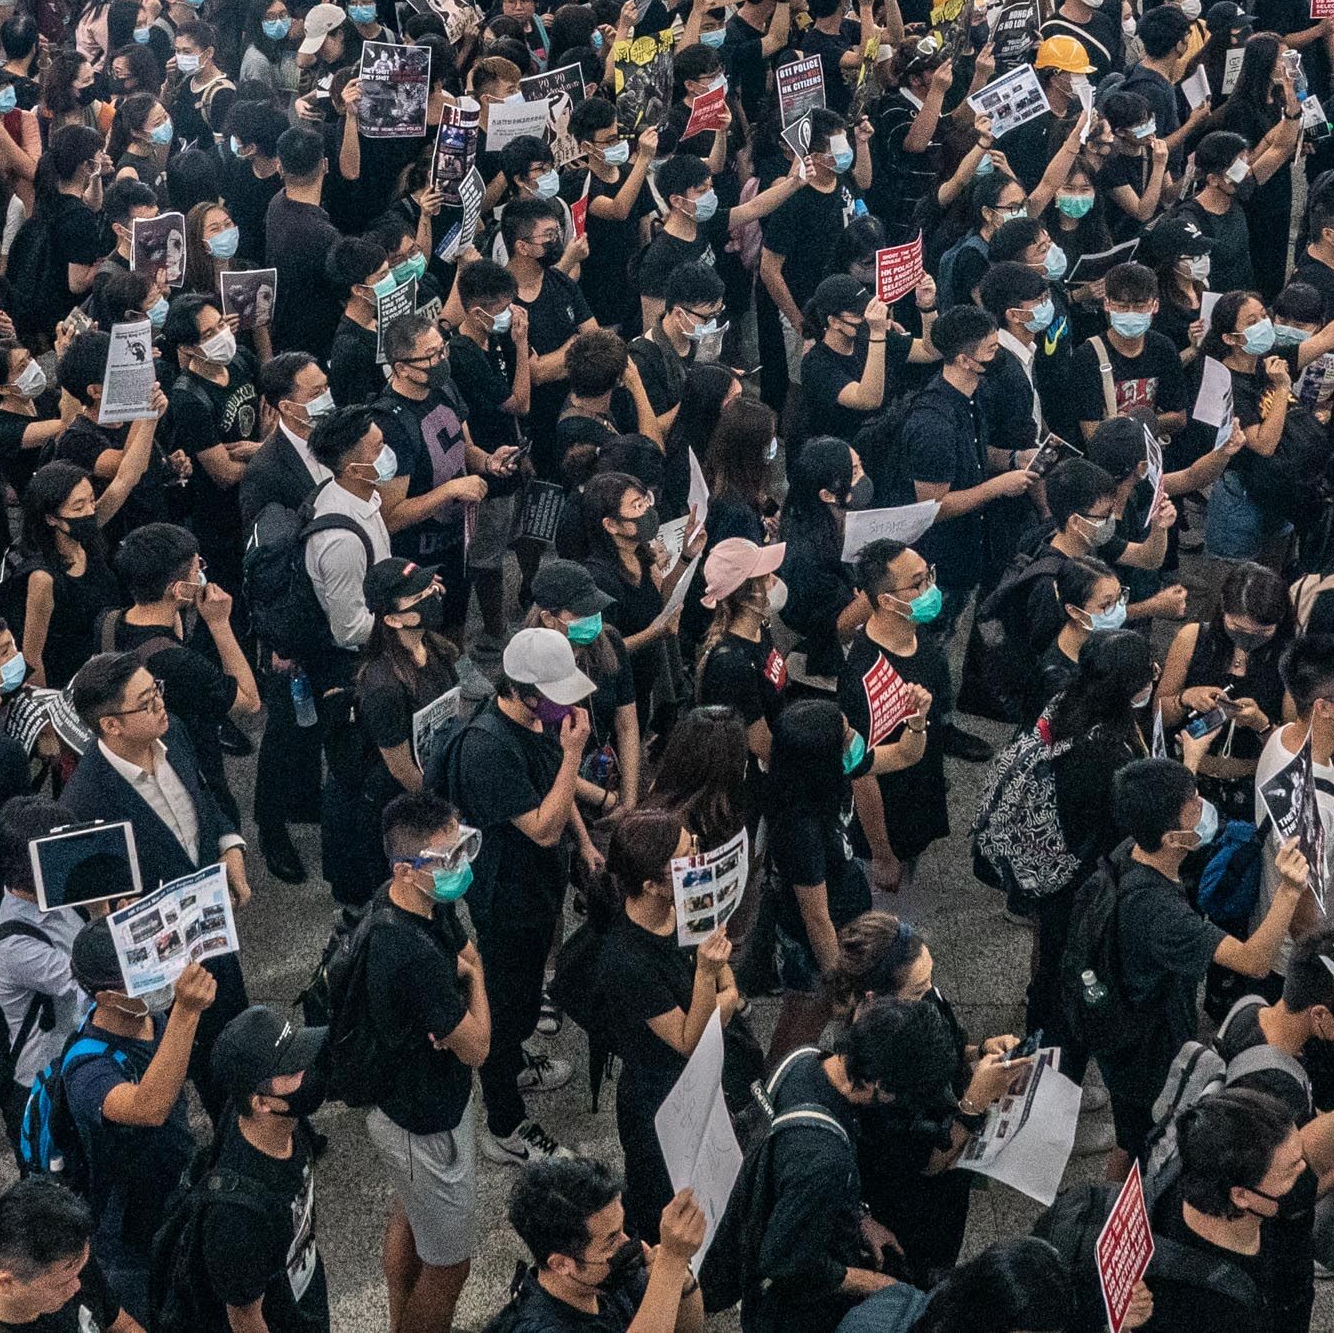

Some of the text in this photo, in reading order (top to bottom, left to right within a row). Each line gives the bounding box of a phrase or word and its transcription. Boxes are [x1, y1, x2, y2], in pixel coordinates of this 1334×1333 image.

[779, 58, 819, 79] 811 POLICE
[782, 74, 821, 94] HK CITIZENS
[882, 252, 898, 260] SHOOT
[881, 261, 913, 277] HK POLICE
[894, 268, 913, 281] ANGRY
[882, 275, 913, 292] SELECTIVE
[391, 286, 409, 299] POLICE
[381, 295, 405, 311] FIRE THE
[381, 299, 408, 316] TEAR GAS
[879, 685, 894, 703] POLICE
[881, 694, 898, 711] ANGRY
